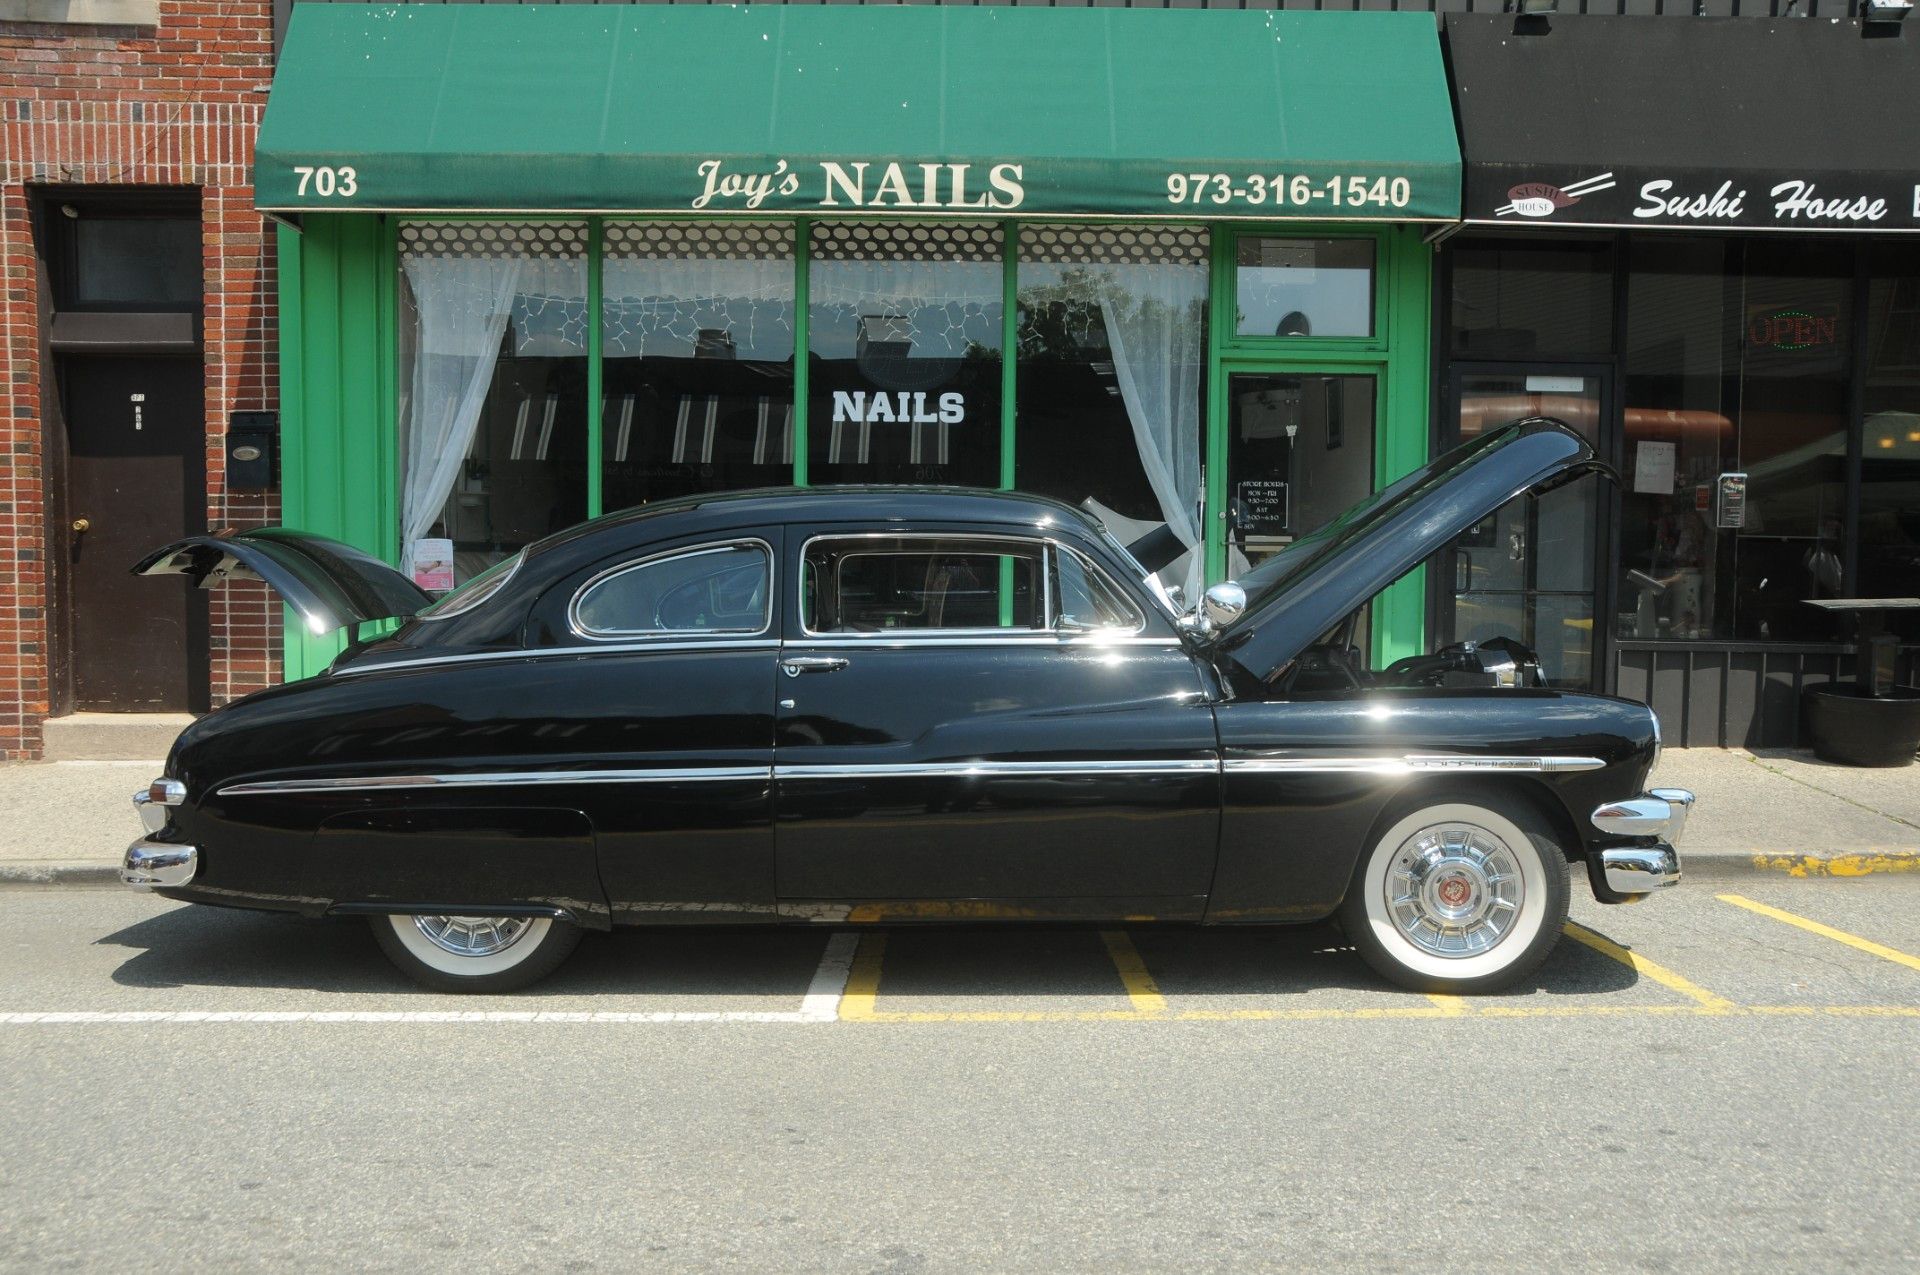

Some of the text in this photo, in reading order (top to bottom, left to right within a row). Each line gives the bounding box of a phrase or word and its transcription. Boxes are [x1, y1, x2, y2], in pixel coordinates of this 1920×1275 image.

[294, 166, 358, 197] 703
[692, 159, 1025, 209] Joy's NAILS
[1167, 173, 1411, 208] 973-316-1540
[1516, 185, 1558, 200] SUSHI
[1518, 202, 1548, 212] HOUSE
[1633, 179, 1747, 219] Sushi
[1770, 180, 1888, 221] House
[1748, 316, 1836, 345] OPEN
[832, 391, 964, 424] NAILS
